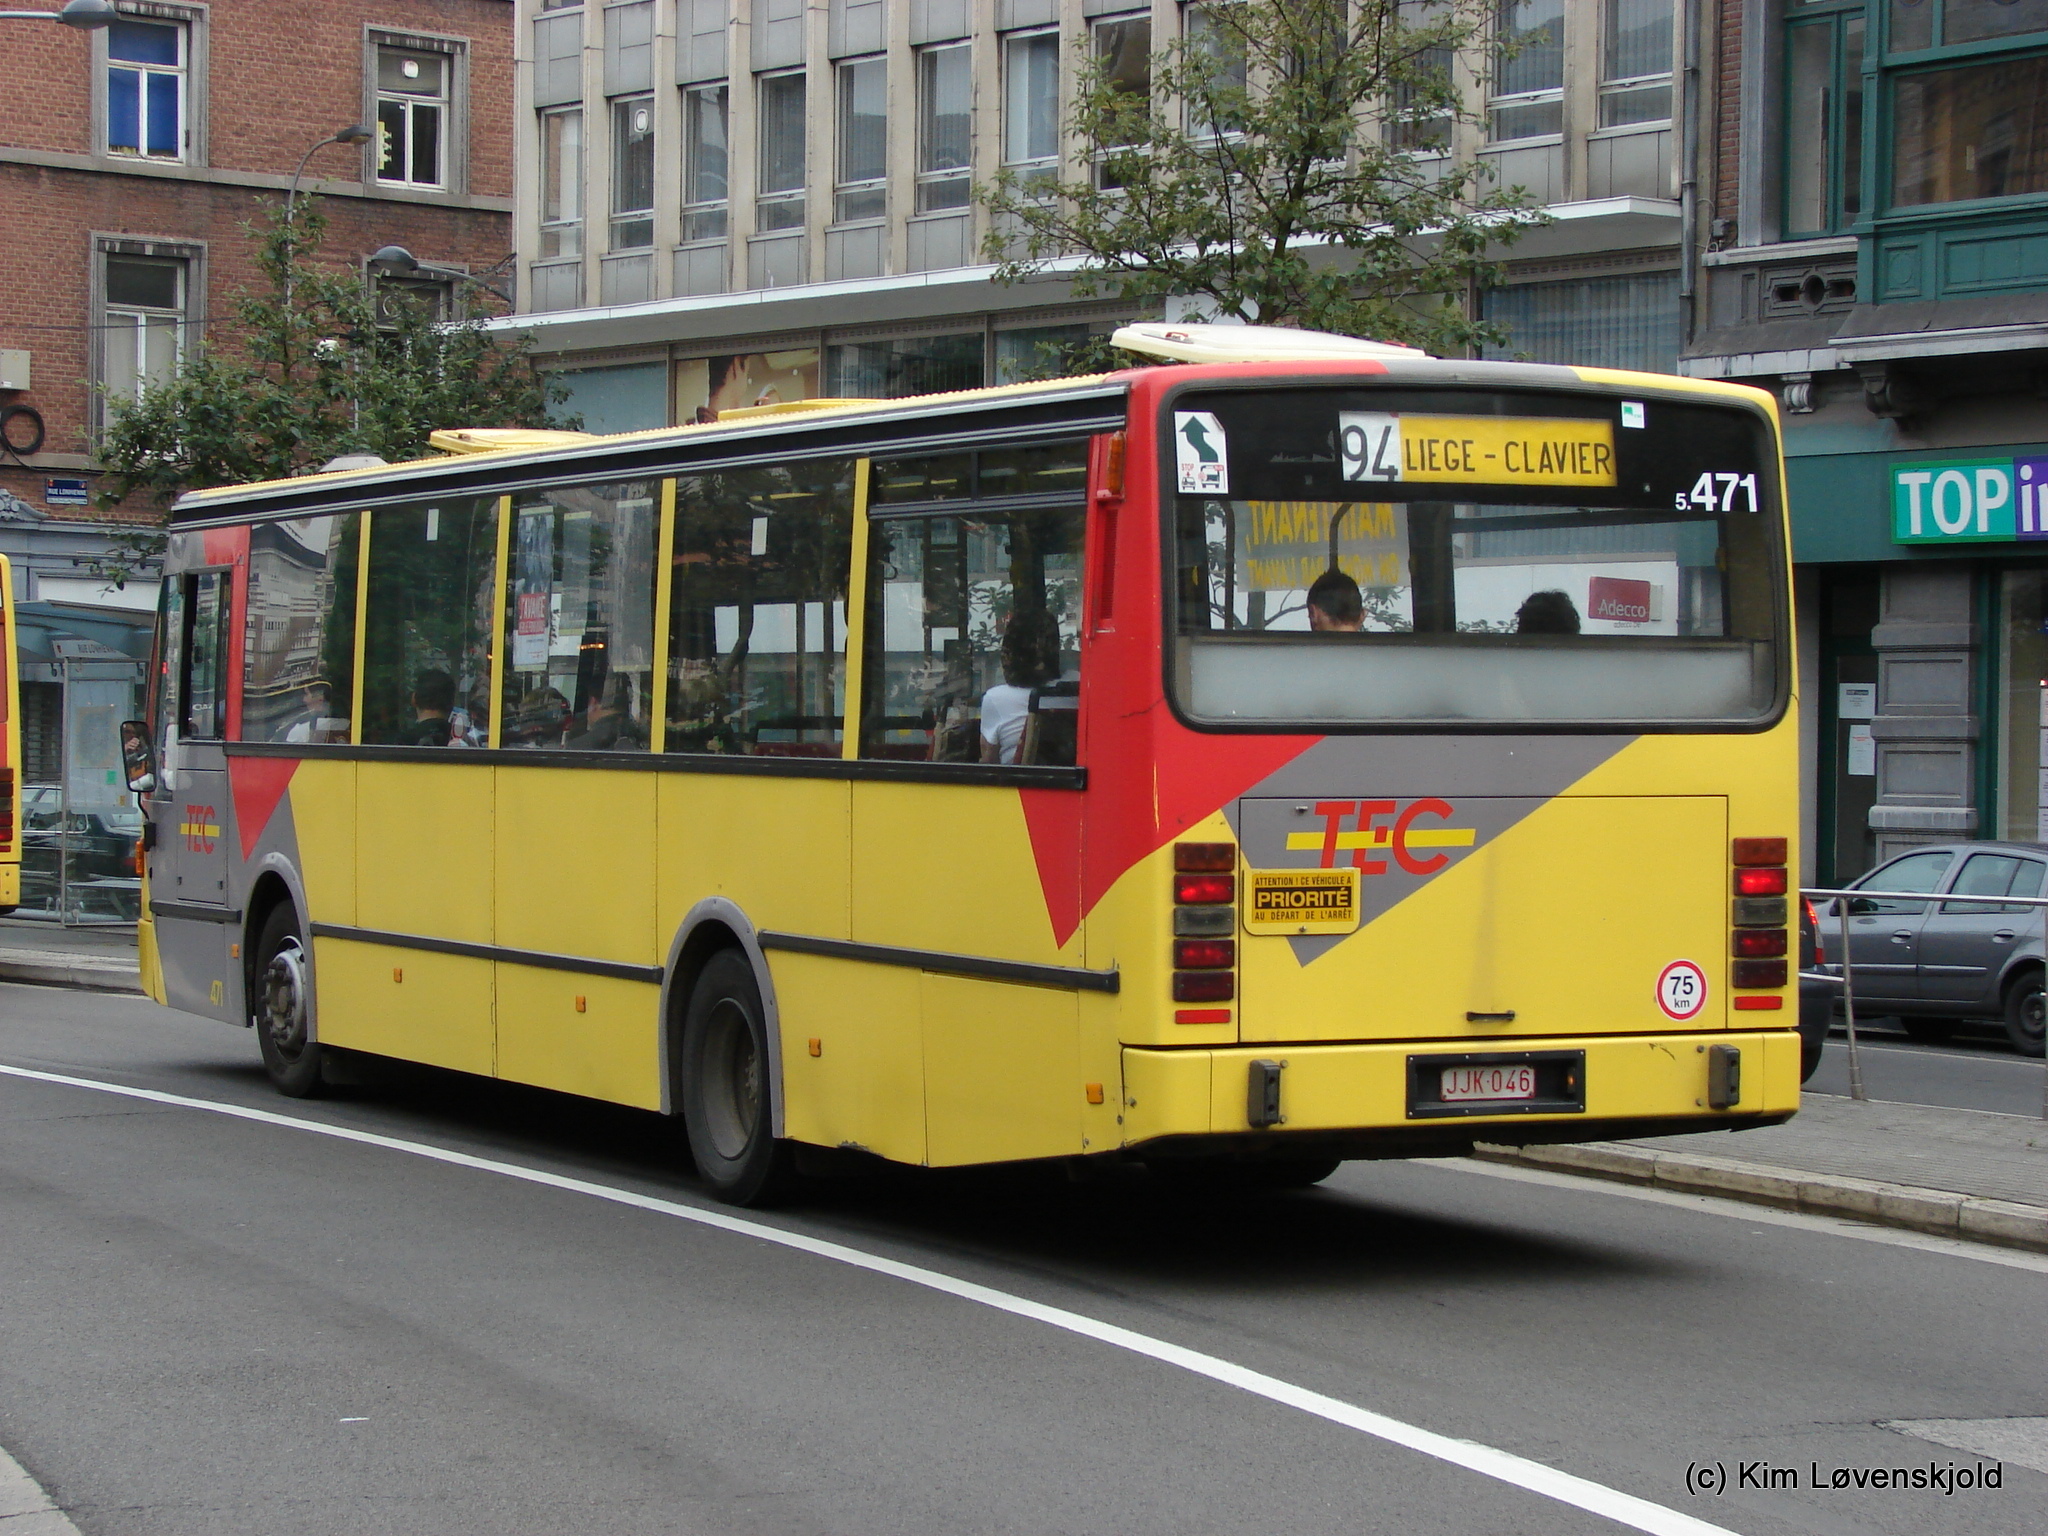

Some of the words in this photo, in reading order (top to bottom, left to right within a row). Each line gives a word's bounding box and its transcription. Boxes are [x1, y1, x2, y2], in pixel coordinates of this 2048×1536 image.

[1341, 425, 1399, 481] 94
[1405, 438, 1476, 472] LIEGE
[1504, 440, 1611, 475] CLAVIER
[1675, 472, 1758, 512] 5.471
[1898, 468, 2009, 535] TOP
[1598, 599, 1646, 617] Adecco
[186, 804, 216, 855] TEC
[1313, 797, 1455, 876] TEC
[1255, 877, 1293, 886] ATTENTION
[1300, 876, 1310, 886] CE
[1312, 875, 1344, 885] VÉHICULE
[1257, 887, 1349, 907] PRIORITÉ
[1255, 912, 1265, 920] AU
[1271, 909, 1299, 920] DÉPART
[1305, 911, 1315, 919] DE
[1320, 908, 1352, 919] L'ARRÊT
[1670, 976, 1693, 995] 75
[1674, 998, 1690, 1008] km
